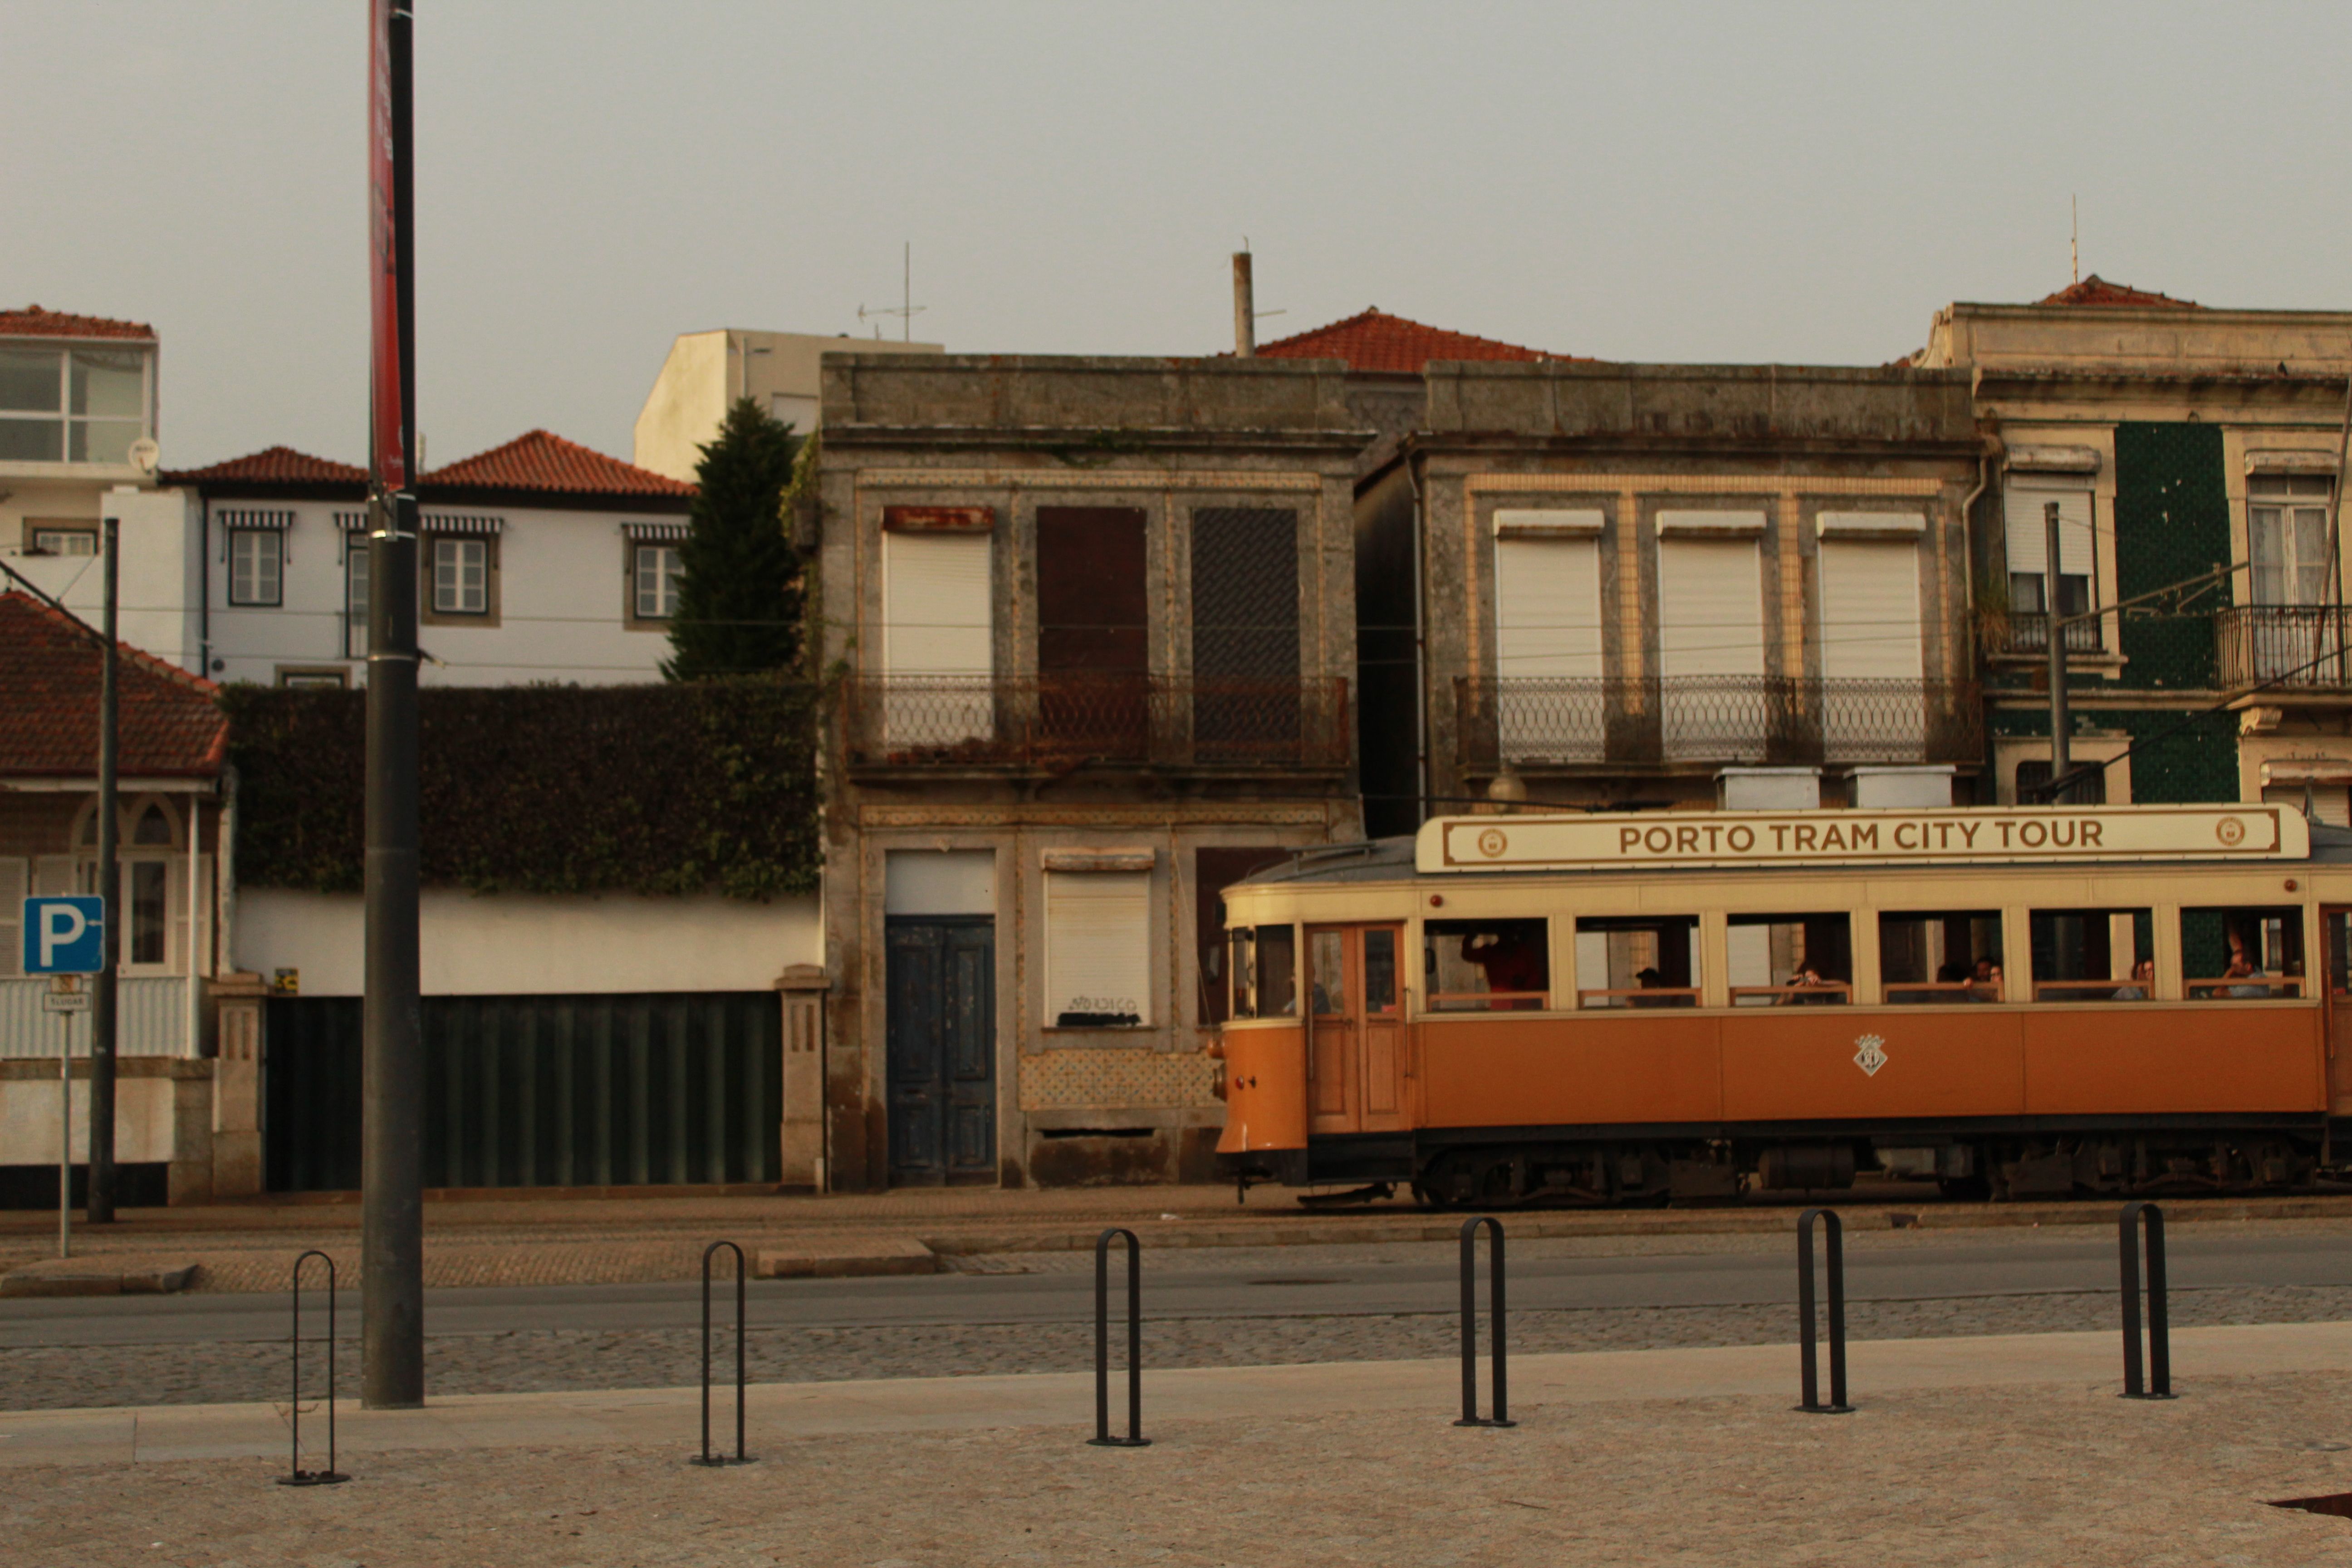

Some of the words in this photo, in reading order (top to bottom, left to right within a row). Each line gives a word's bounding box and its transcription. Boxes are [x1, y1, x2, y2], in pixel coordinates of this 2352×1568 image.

[1620, 826, 1755, 854] PORTO
[1769, 823, 1878, 852] TRAM
[1894, 822, 1981, 850] CITY
[1994, 820, 2102, 848] TOUR
[40, 904, 86, 967] P
